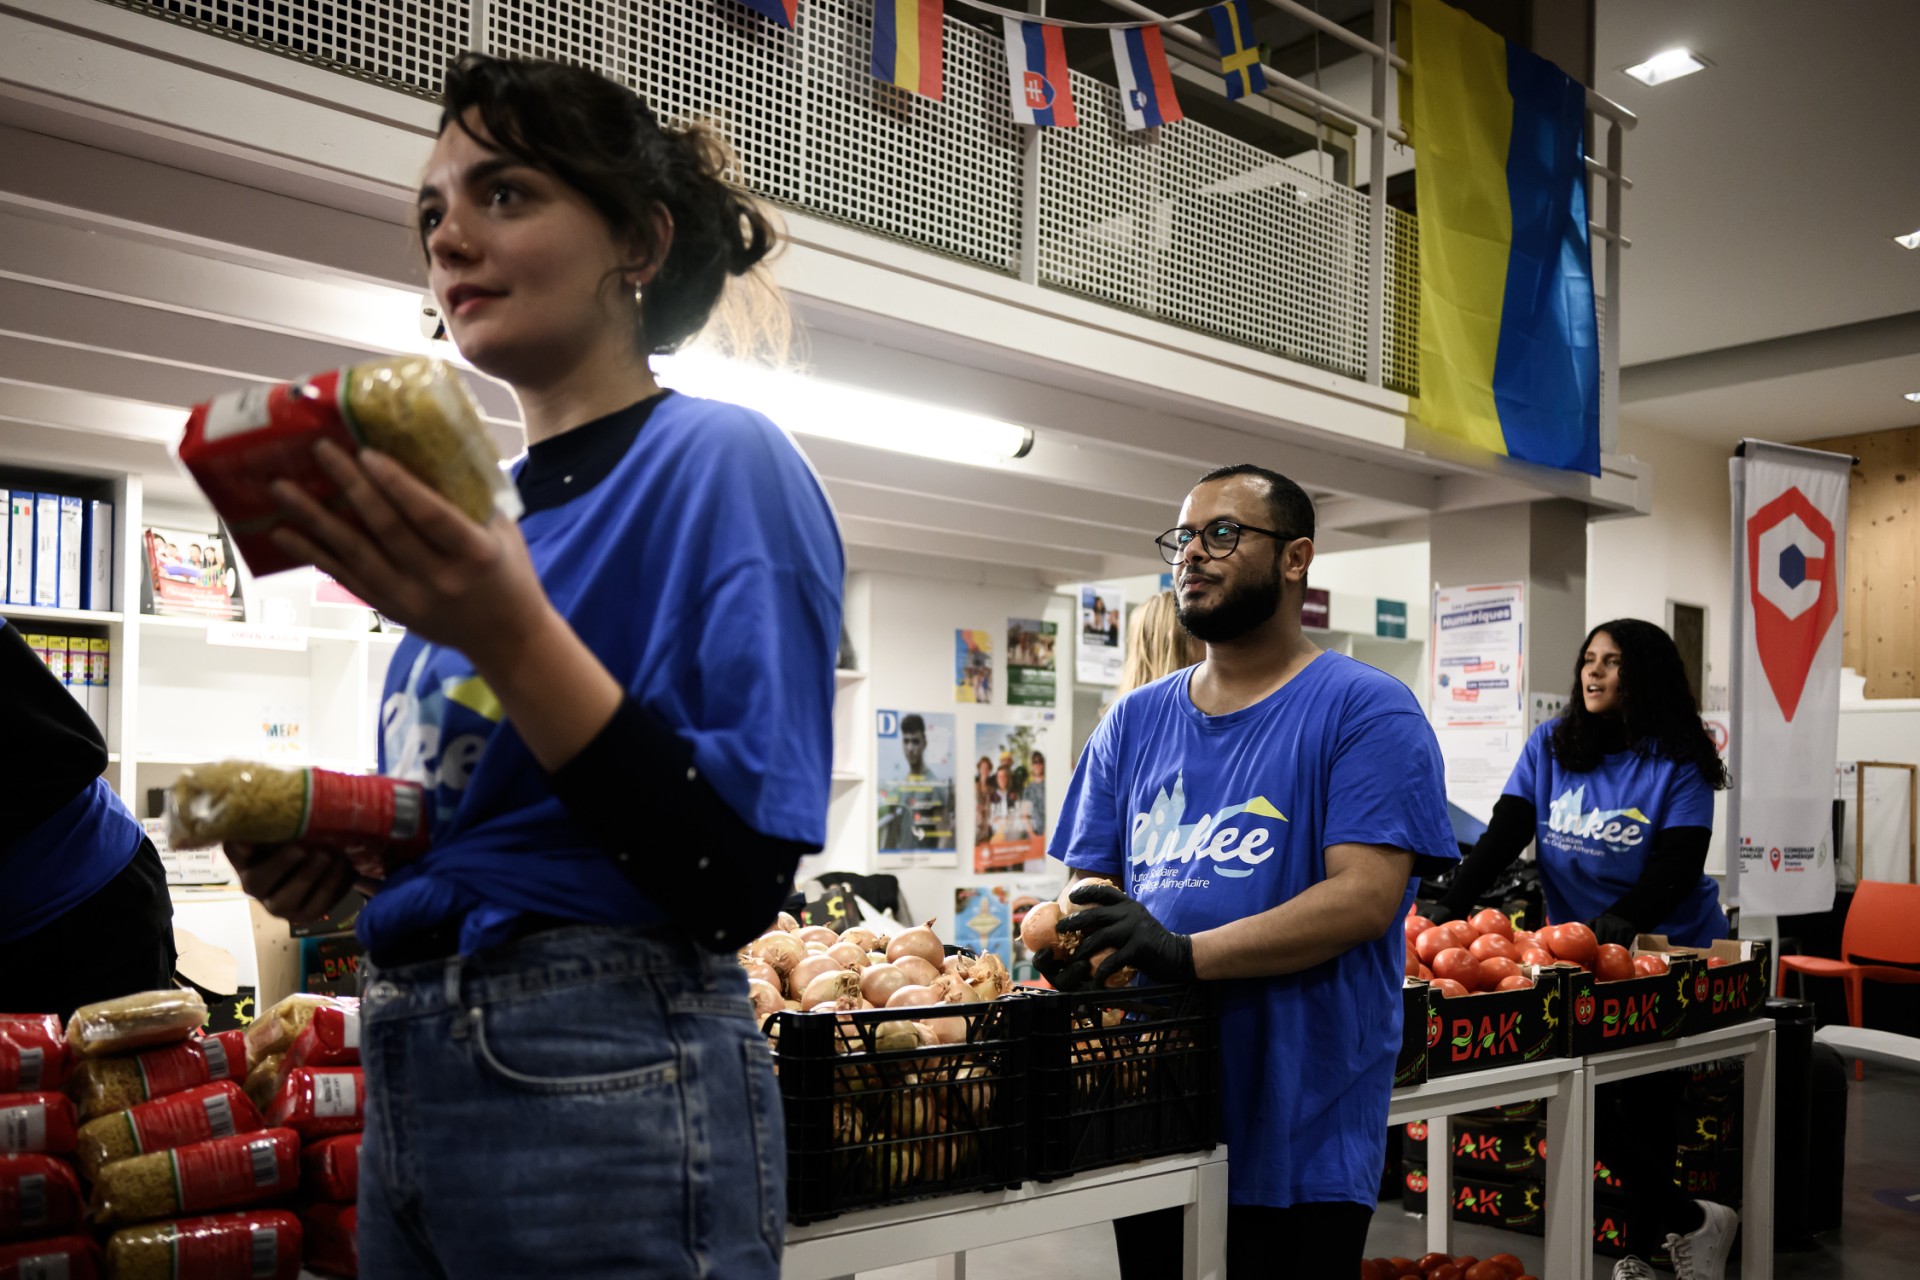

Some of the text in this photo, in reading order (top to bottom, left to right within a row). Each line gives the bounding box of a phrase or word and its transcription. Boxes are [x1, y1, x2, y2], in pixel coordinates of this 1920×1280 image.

[1442, 608, 1510, 628] Numériques
[878, 712, 897, 735] D
[324, 954, 359, 978] BAK
[1711, 971, 1748, 1014] BAK
[1603, 992, 1658, 1038] BAK
[1452, 1011, 1519, 1062] BAK
[1452, 1132, 1500, 1162] AK
[1688, 1170, 1719, 1191] BAK
[1452, 1186, 1500, 1216] AK
